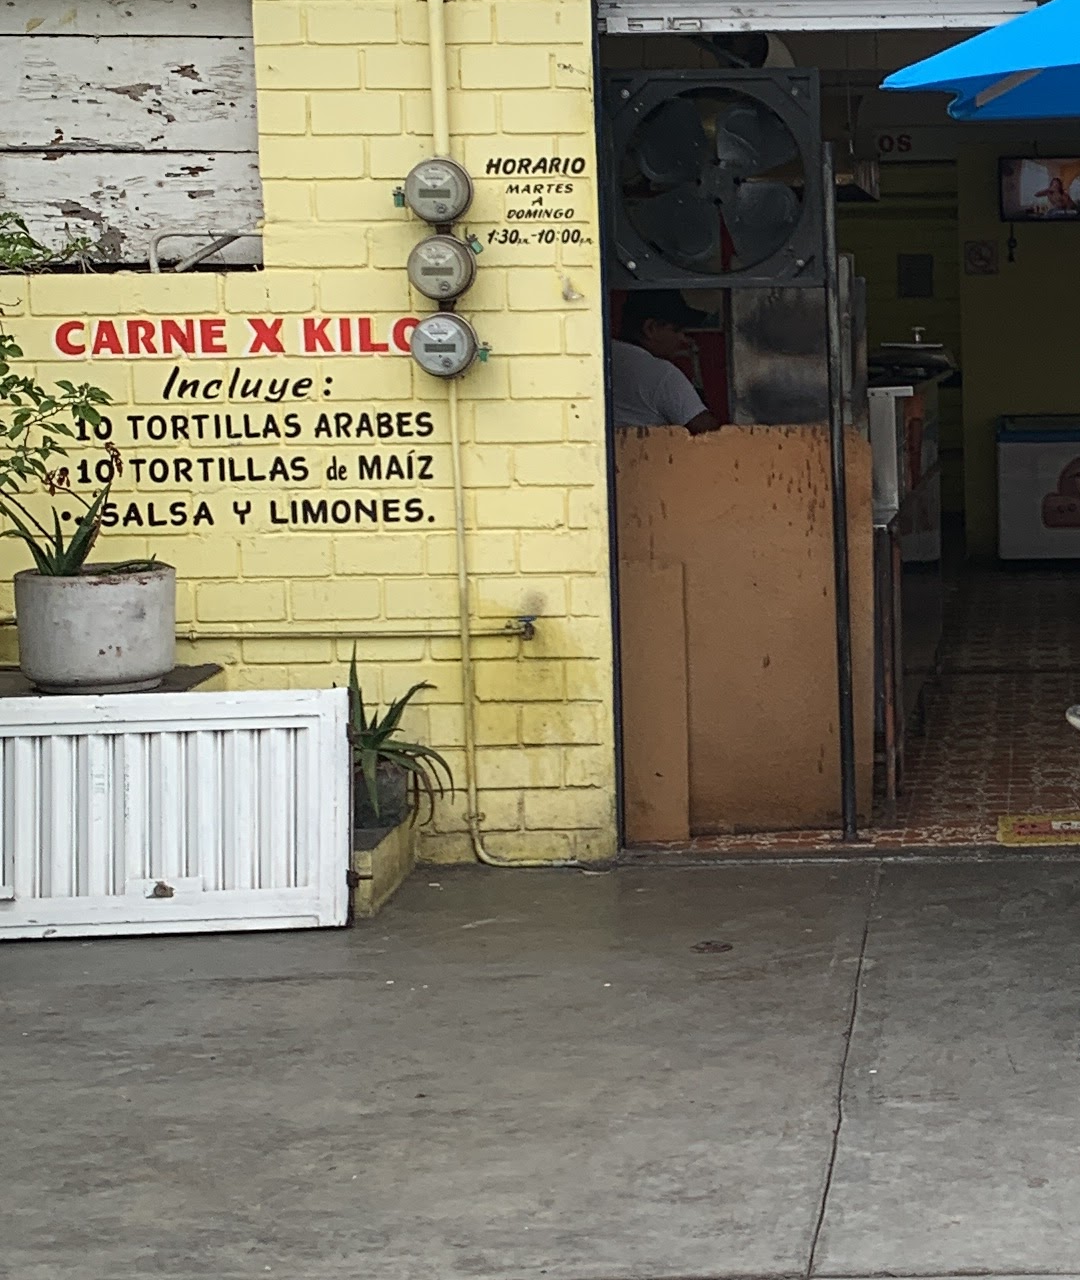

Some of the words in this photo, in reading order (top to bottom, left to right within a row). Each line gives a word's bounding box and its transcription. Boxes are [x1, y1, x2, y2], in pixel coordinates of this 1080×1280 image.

[485, 156, 586, 175] HORARIO
[505, 182, 574, 195] MARTES
[531, 195, 543, 206] A
[506, 208, 575, 220] DOMINGO
[55, 319, 228, 355] CARNE
[247, 318, 285, 354] X
[162, 366, 333, 403] Incluye:
[75, 415, 113, 441] 10
[127, 414, 301, 441] TORTILLAS
[314, 411, 434, 438] ARABES
[129, 456, 309, 484] TORTILLAS
[326, 455, 347, 482] de
[358, 450, 434, 482] MAÍZ
[100, 501, 214, 527] SALSA
[232, 500, 252, 525] Y
[270, 498, 435, 525] LIMONES.
